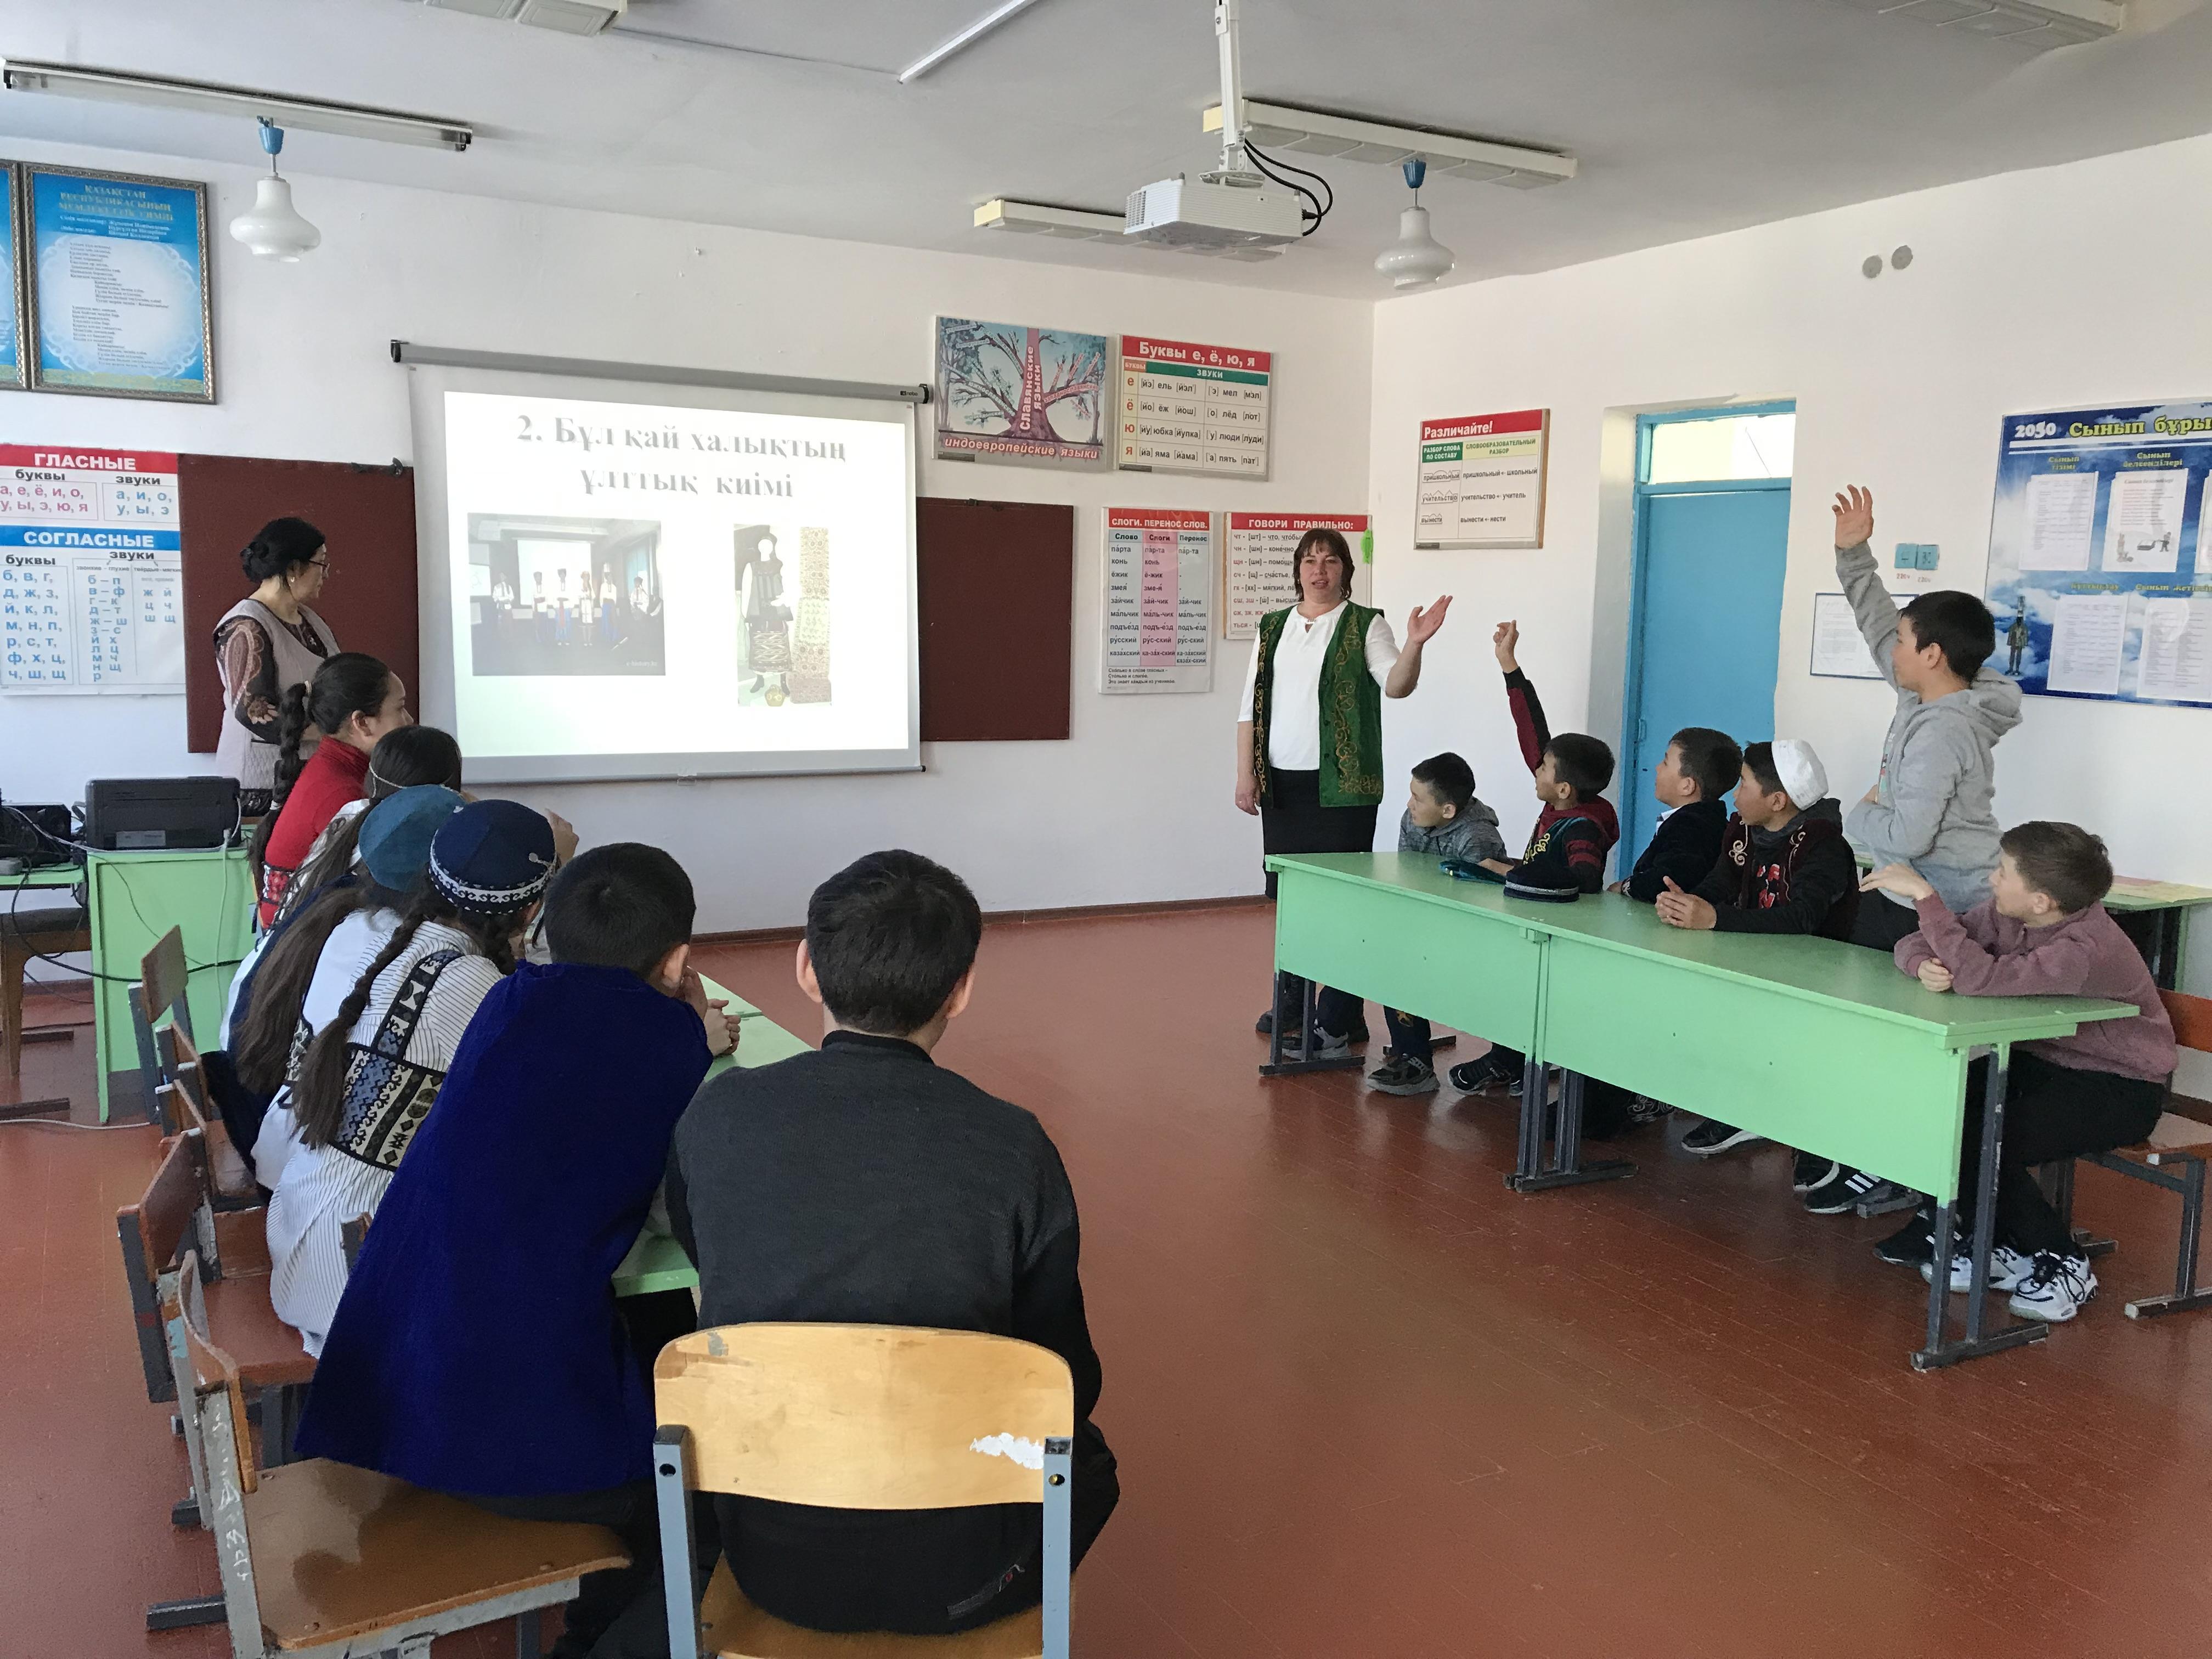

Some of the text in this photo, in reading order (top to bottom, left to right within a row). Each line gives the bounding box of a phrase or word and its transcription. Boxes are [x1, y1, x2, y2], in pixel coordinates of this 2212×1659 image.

[1139, 341, 1186, 358] Буквы
[1227, 355, 1242, 367] ю,
[1247, 357, 1255, 366] я
[1127, 377, 1134, 386] е
[1020, 347, 1034, 430] славянские
[1159, 404, 1169, 413] ёж
[1222, 410, 1237, 419] лёд
[517, 415, 542, 441] 2.
[555, 417, 614, 452] Бұл
[1424, 421, 1493, 439] Различайте!
[2015, 421, 2057, 438] 2050
[2069, 420, 2146, 437] Сынып
[1220, 433, 1240, 442] люди
[945, 438, 1097, 459] индоевропейские языки
[35, 453, 136, 470] ГЛАСНЫЕ
[15, 469, 65, 482] буквы
[1463, 471, 1500, 479] пришкольный
[1506, 467, 1537, 476] школьный
[116, 476, 160, 486] звуки
[716, 472, 793, 497] киімі
[161, 506, 169, 515] э
[1249, 519, 1353, 529] ГОВОРИ ПРАВИЛЬНО:
[24, 531, 154, 548] СОГЛАСНЫЕ
[5, 555, 55, 566] буквы
[110, 552, 154, 561] звуки
